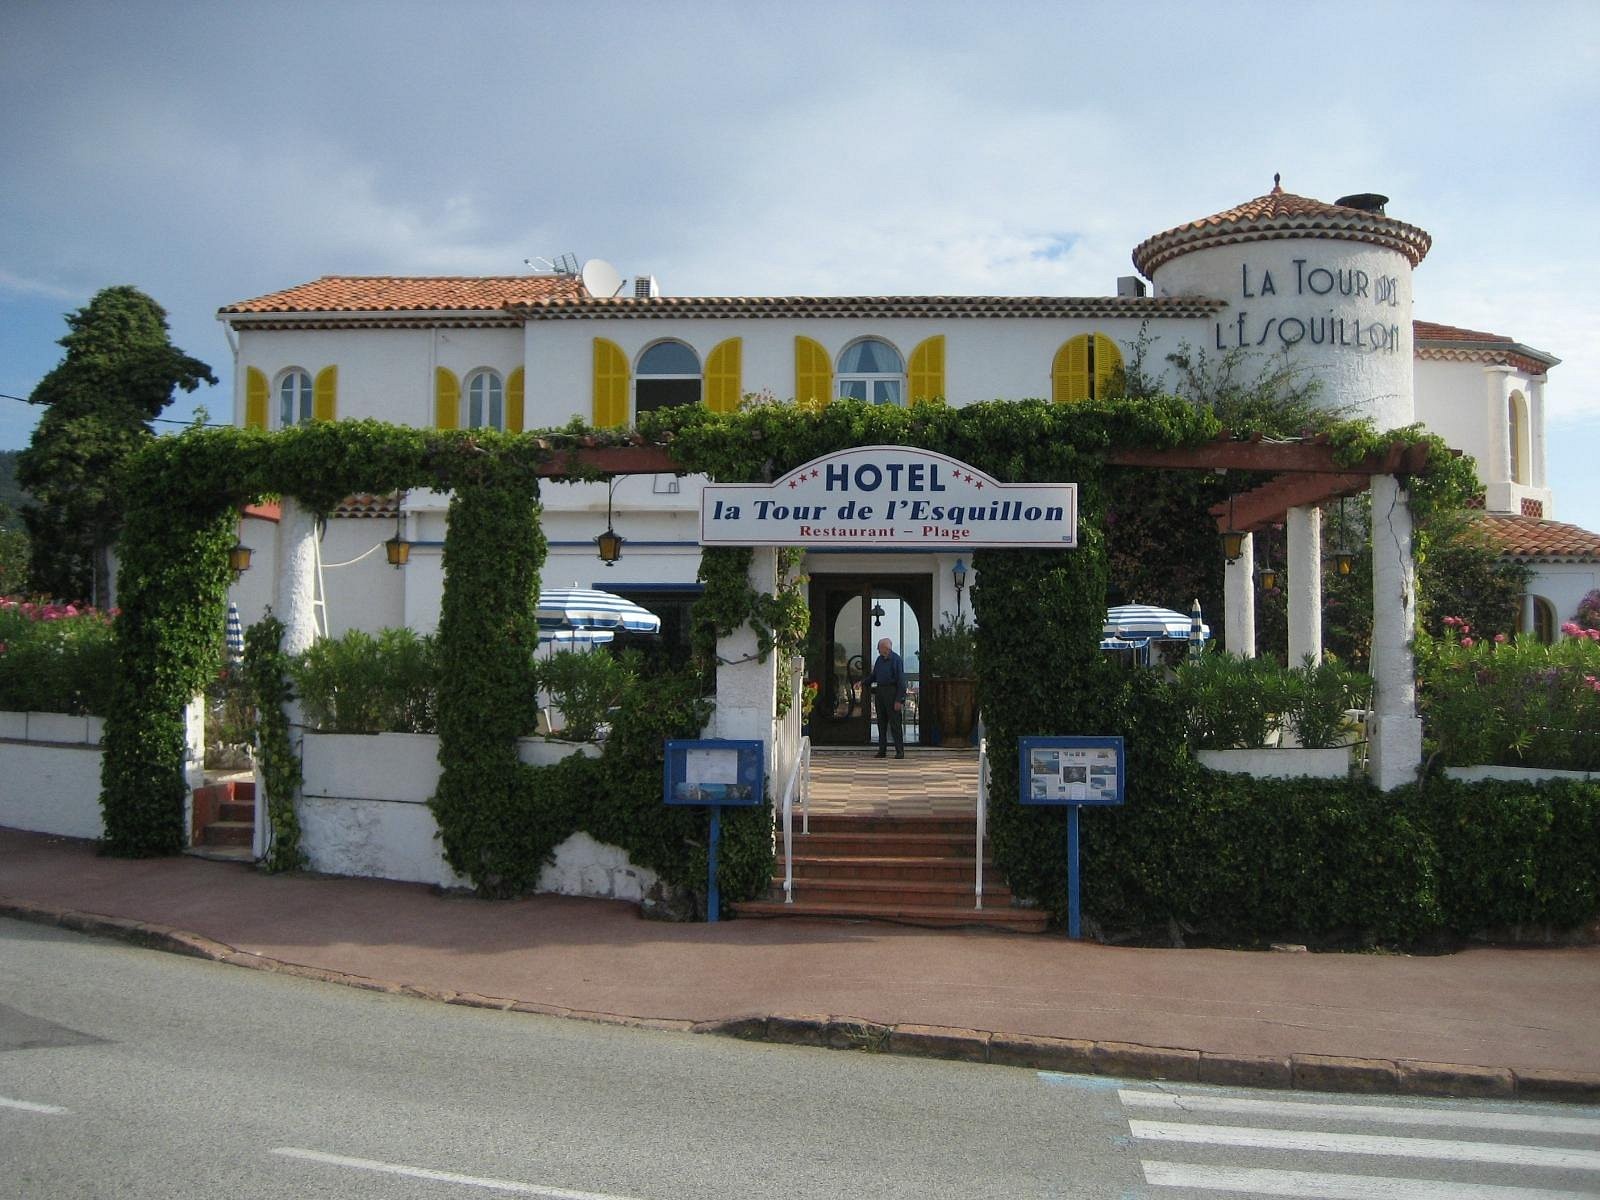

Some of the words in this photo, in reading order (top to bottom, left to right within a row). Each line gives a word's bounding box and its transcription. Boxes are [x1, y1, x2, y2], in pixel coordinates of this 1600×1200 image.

[1242, 263, 1276, 298] LA
[1292, 259, 1369, 298] TOUR
[825, 463, 946, 492] HOTEL
[712, 500, 741, 521] la
[753, 500, 827, 521] Tour
[837, 500, 873, 521] de
[885, 500, 1064, 525] l'Esquillon
[799, 525, 896, 538] Restaurant
[922, 525, 971, 541] Plage
